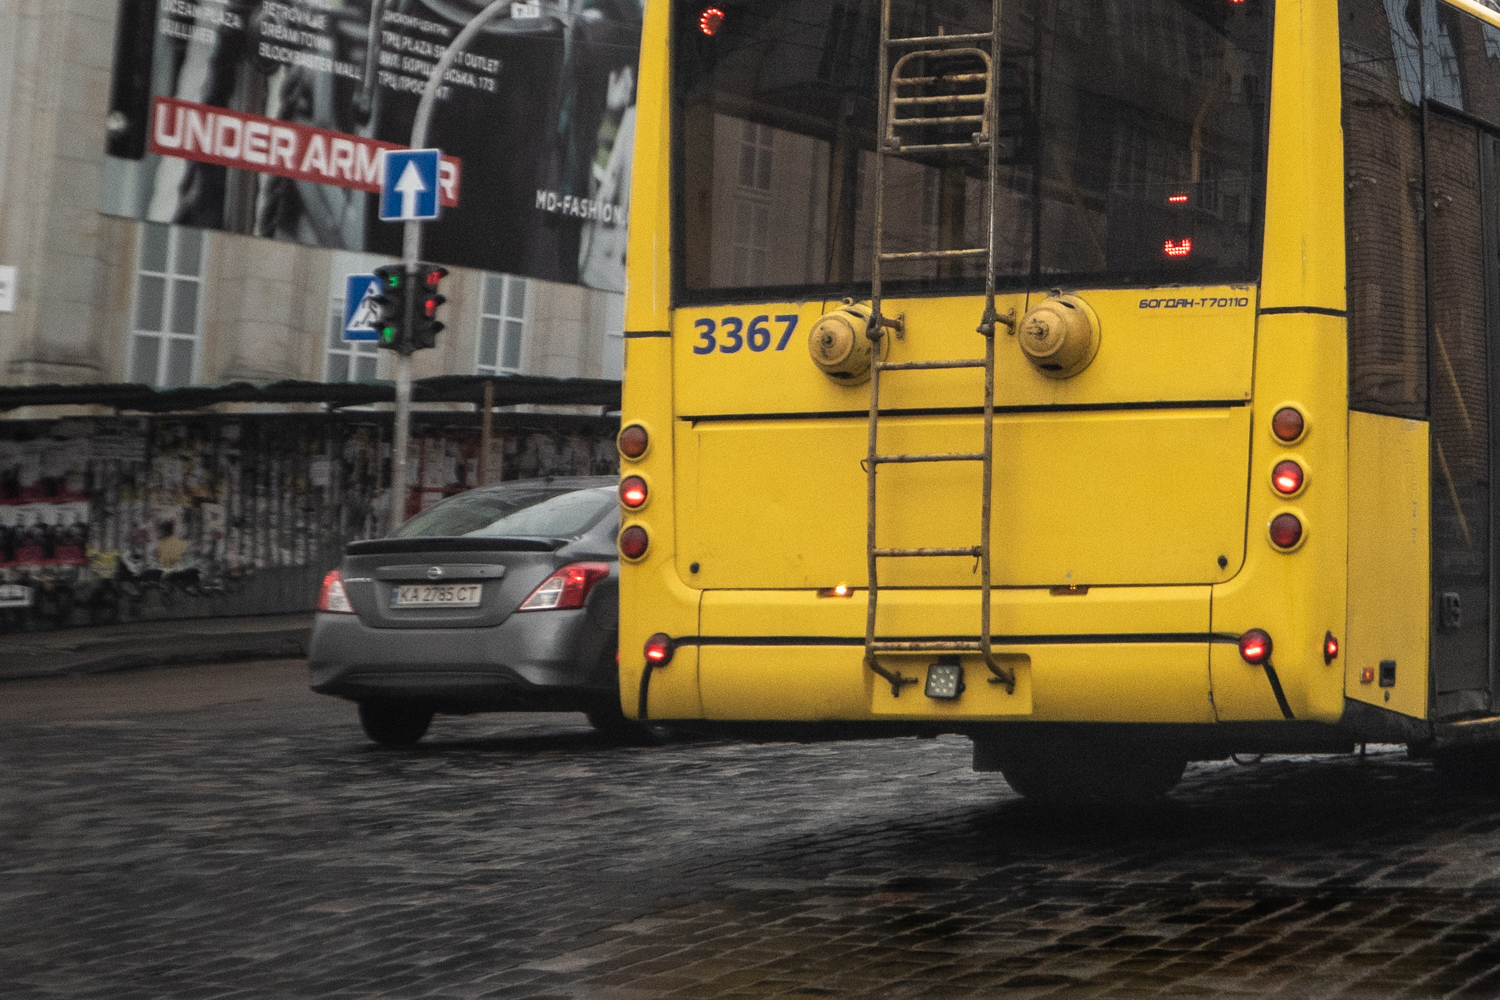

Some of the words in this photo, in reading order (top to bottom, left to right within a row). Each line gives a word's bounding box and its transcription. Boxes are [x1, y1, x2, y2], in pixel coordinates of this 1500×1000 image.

[260, 21, 298, 44] DREAM
[299, 32, 335, 52] TOWN
[401, 36, 432, 56] PLAZA
[464, 53, 502, 76] OUTLET
[397, 77, 452, 100] ПРОСКТ
[153, 102, 299, 170] UNDER
[300, 134, 457, 200] ARMR
[692, 314, 799, 355] 3367
